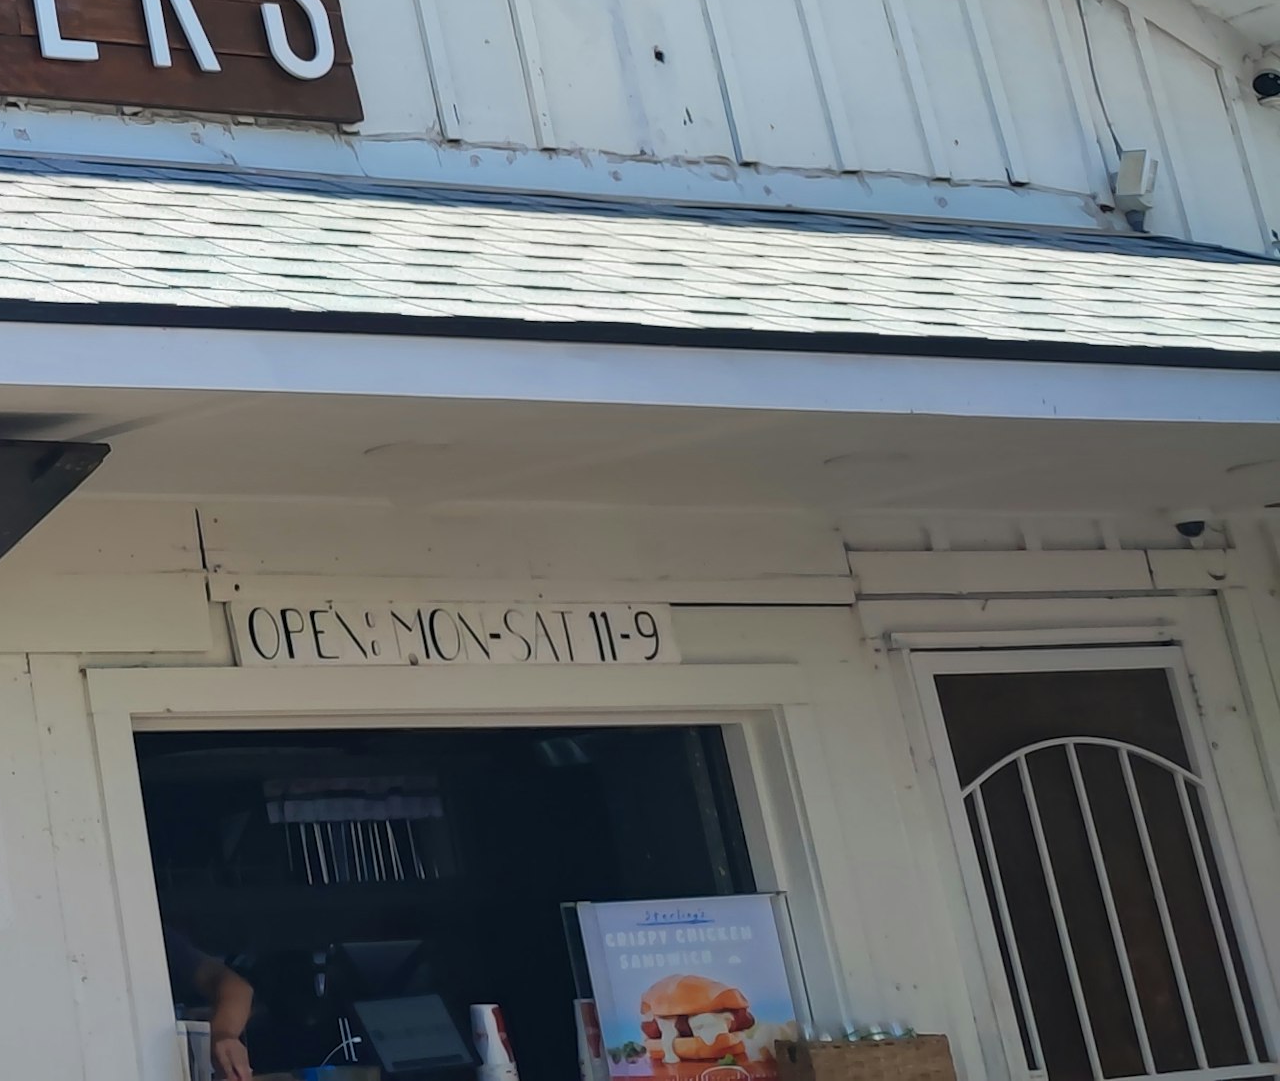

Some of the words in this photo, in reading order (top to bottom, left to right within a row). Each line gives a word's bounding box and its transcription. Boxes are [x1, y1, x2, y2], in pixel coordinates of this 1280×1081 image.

[248, 605, 382, 661] OPEN:
[390, 607, 577, 662] MON-SAT
[588, 609, 661, 662] 11-9
[605, 929, 667, 948] CRISPY
[675, 925, 753, 944] CHICKEN
[619, 950, 712, 970] SANDWICH
